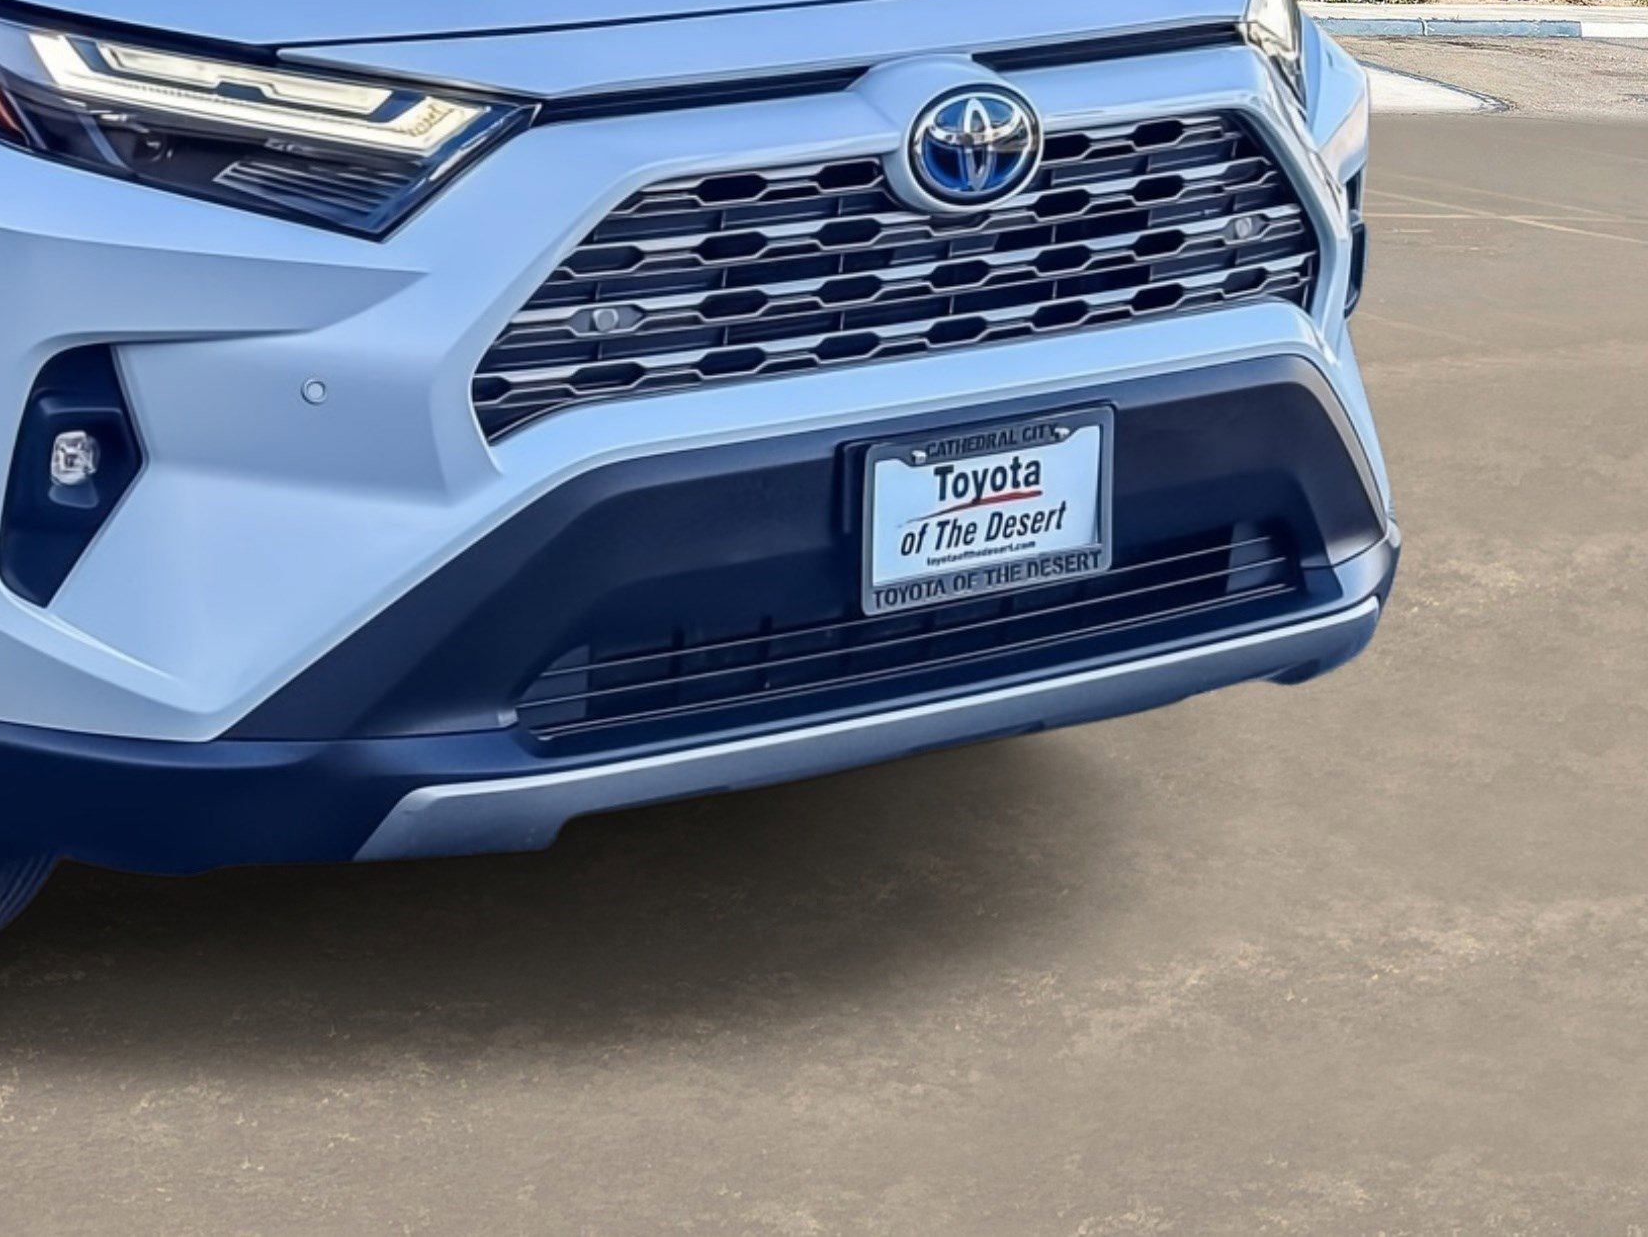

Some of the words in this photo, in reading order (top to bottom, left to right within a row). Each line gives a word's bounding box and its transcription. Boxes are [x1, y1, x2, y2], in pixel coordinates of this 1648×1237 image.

[925, 431, 1018, 459] CATHEDRAL
[1021, 422, 1059, 443] CITY
[933, 455, 1042, 505] Toyota
[900, 520, 930, 557] of
[935, 517, 976, 551] The
[984, 500, 1067, 542] Desert
[872, 580, 947, 610] TOYOTA
[952, 574, 979, 592] OF
[983, 561, 1023, 587] THE
[1026, 548, 1103, 579] DESERT
